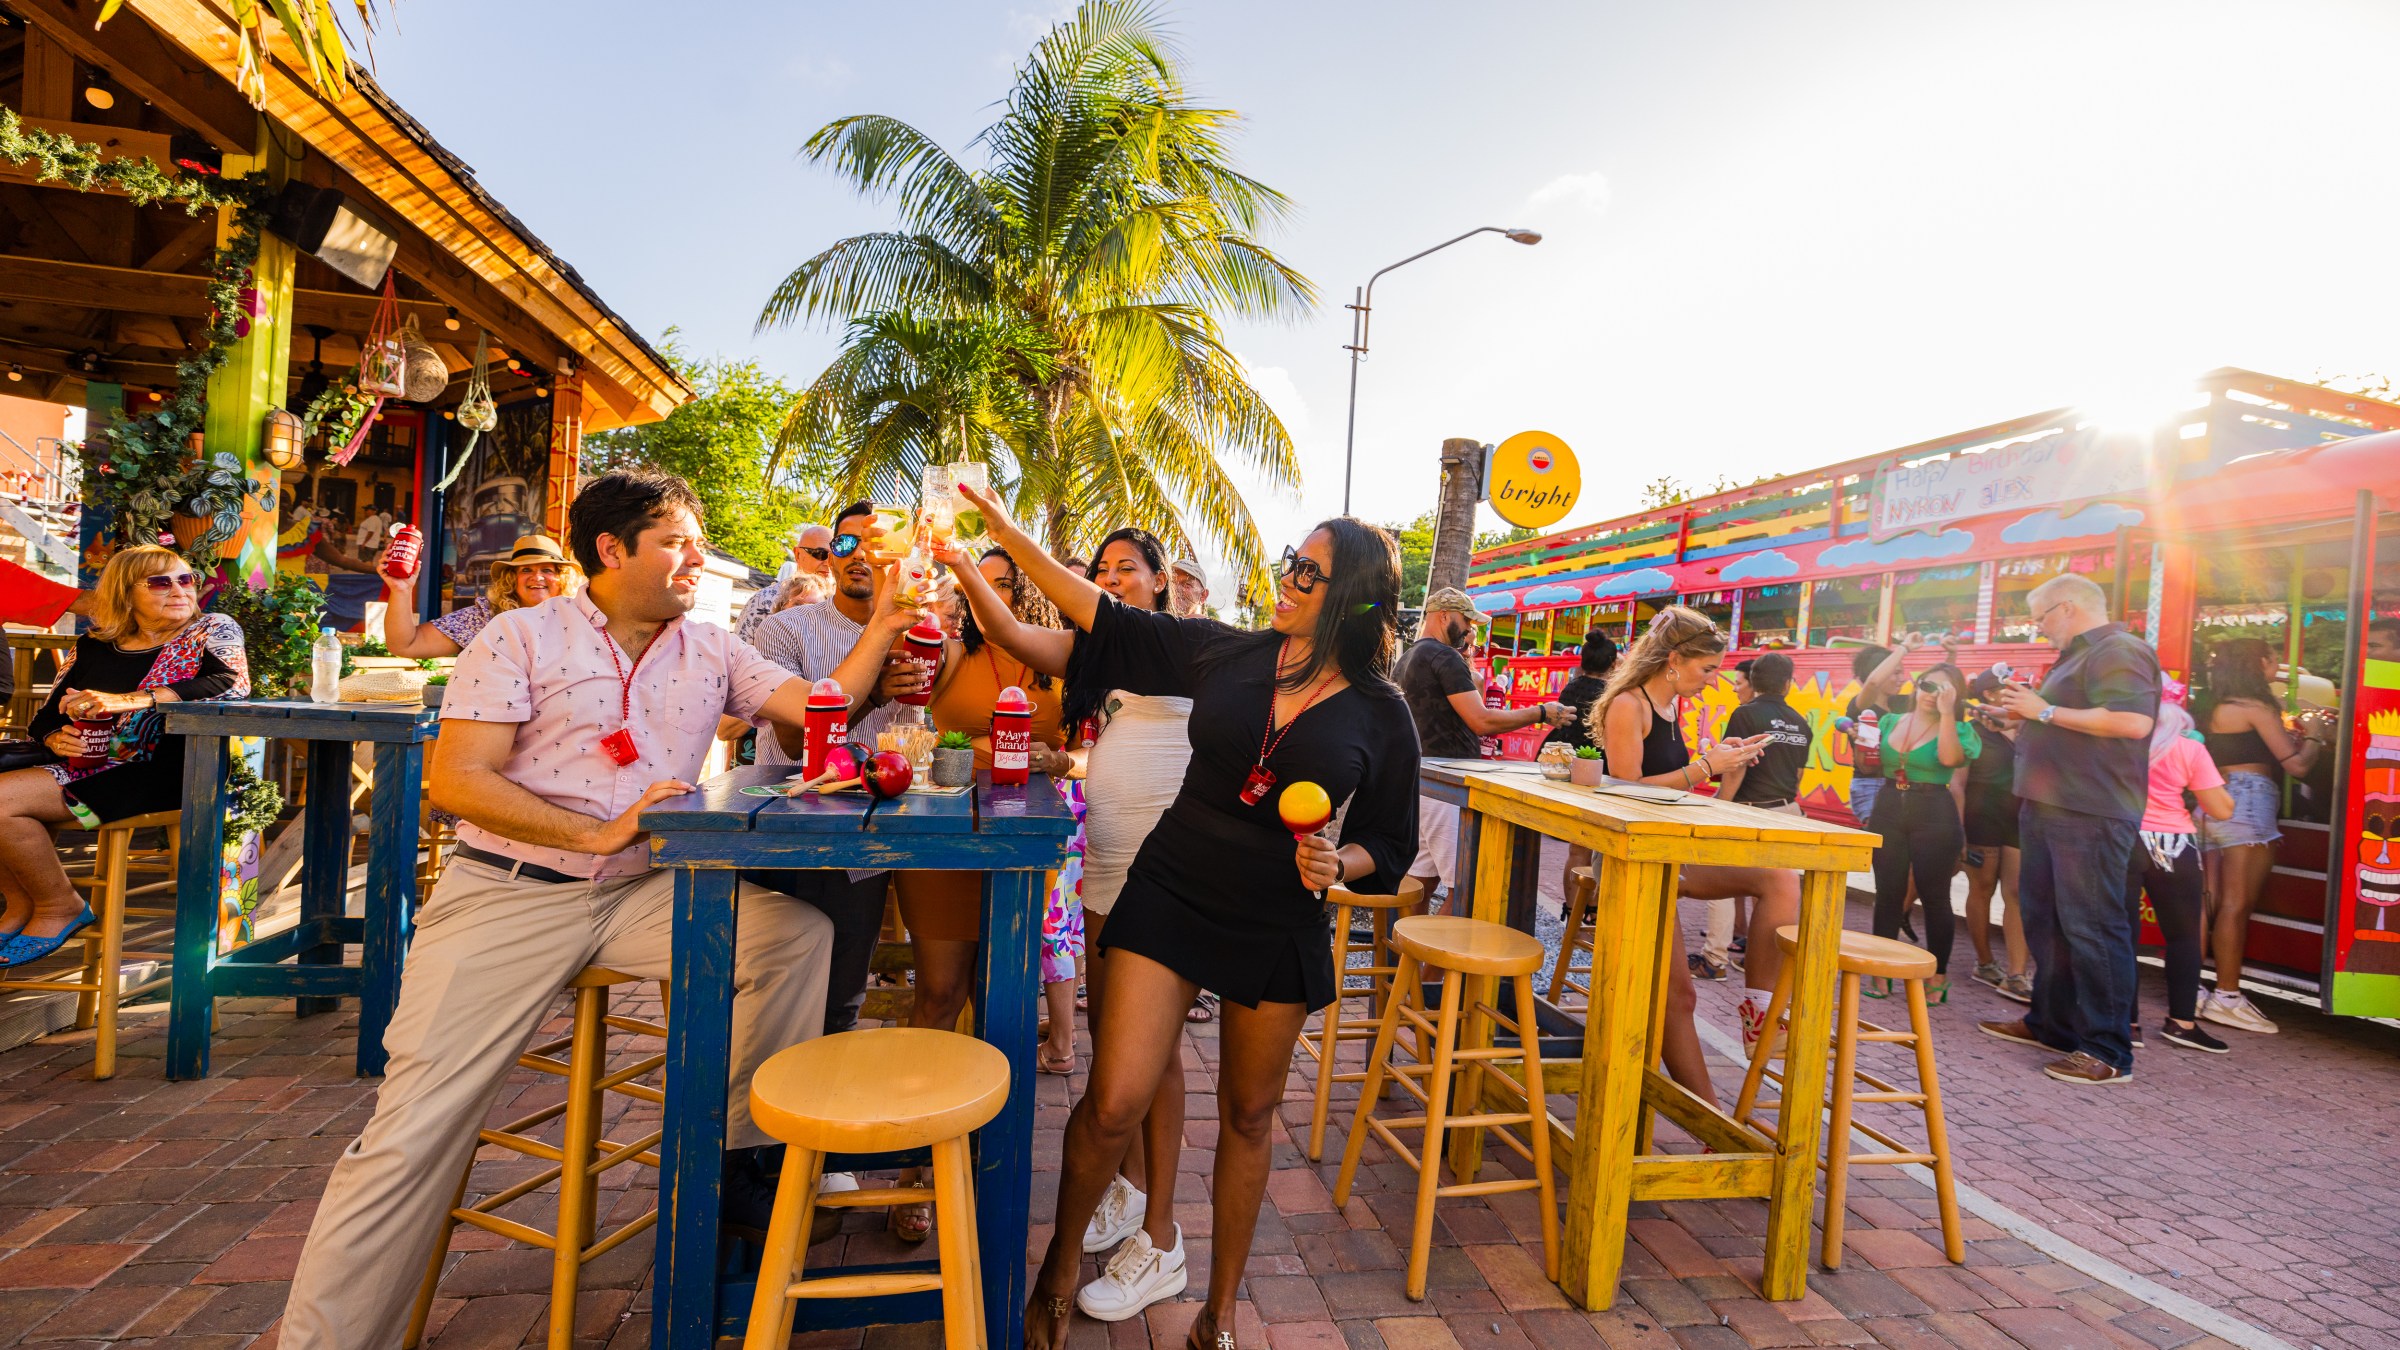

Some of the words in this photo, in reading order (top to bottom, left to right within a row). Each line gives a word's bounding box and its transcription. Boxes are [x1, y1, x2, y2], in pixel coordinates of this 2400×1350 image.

[1500, 479, 1572, 509] bright
[1895, 460, 1951, 498] Happy
[1004, 730, 1024, 742] Aay
